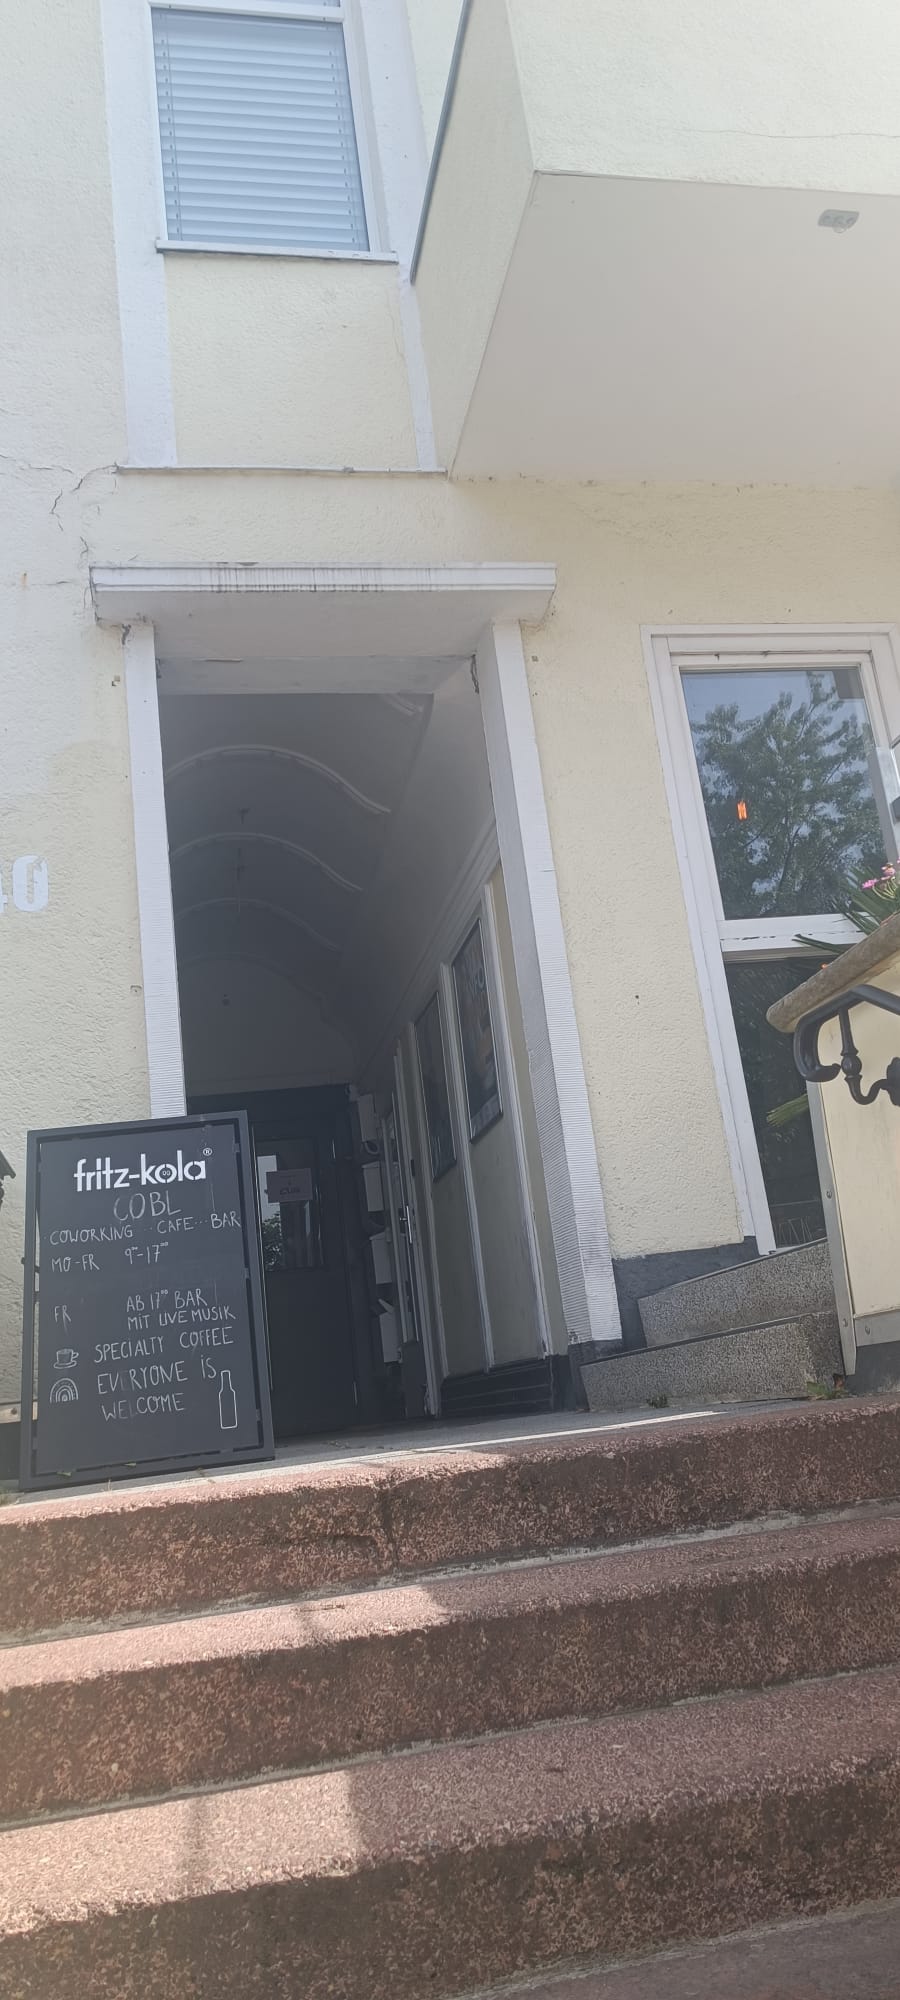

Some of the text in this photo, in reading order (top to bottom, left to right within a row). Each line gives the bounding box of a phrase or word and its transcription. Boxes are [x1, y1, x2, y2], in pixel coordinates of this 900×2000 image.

[0, 854, 49, 915] 0
[113, 1190, 182, 1222] COBL
[49, 1224, 134, 1246] COWORKING
[53, 1304, 72, 1323] FR
[126, 1295, 145, 1313] AB
[174, 1288, 208, 1309] BAR
[191, 1305, 236, 1323] MUSIK
[93, 1326, 234, 1364] SPECIALTY COFFEE
